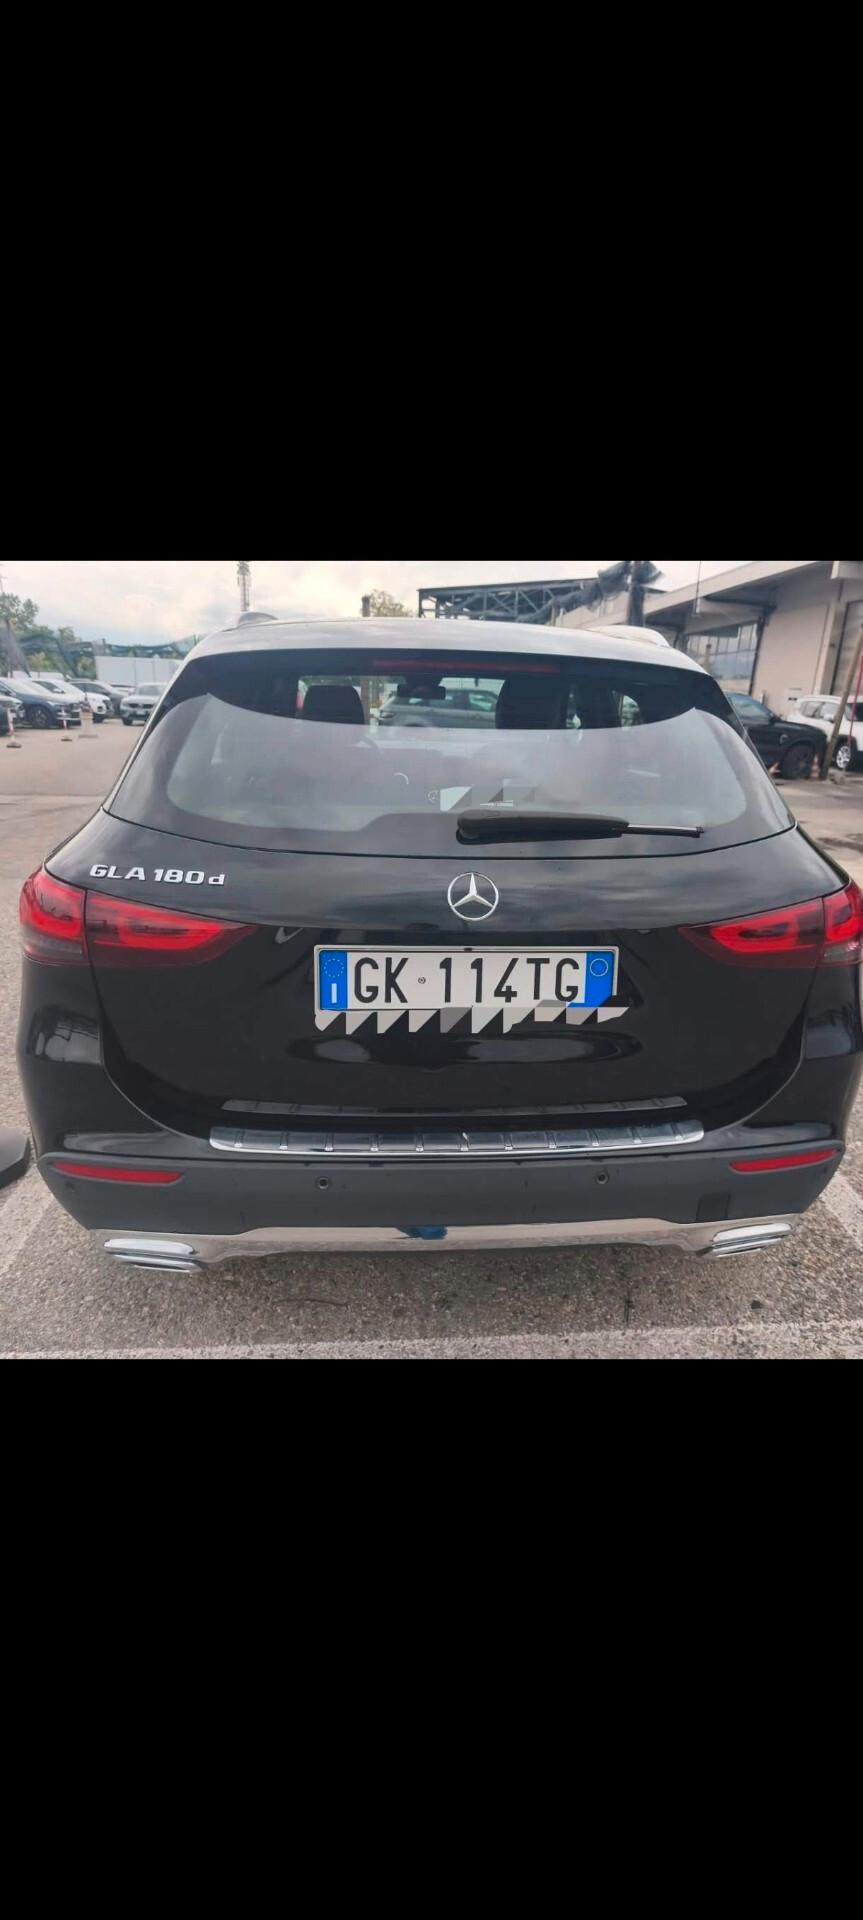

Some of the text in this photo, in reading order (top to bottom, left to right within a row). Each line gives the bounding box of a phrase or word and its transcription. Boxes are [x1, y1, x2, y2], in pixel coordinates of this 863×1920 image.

[89, 864, 146, 881] GLA
[354, 956, 580, 1004] GK 114TG
